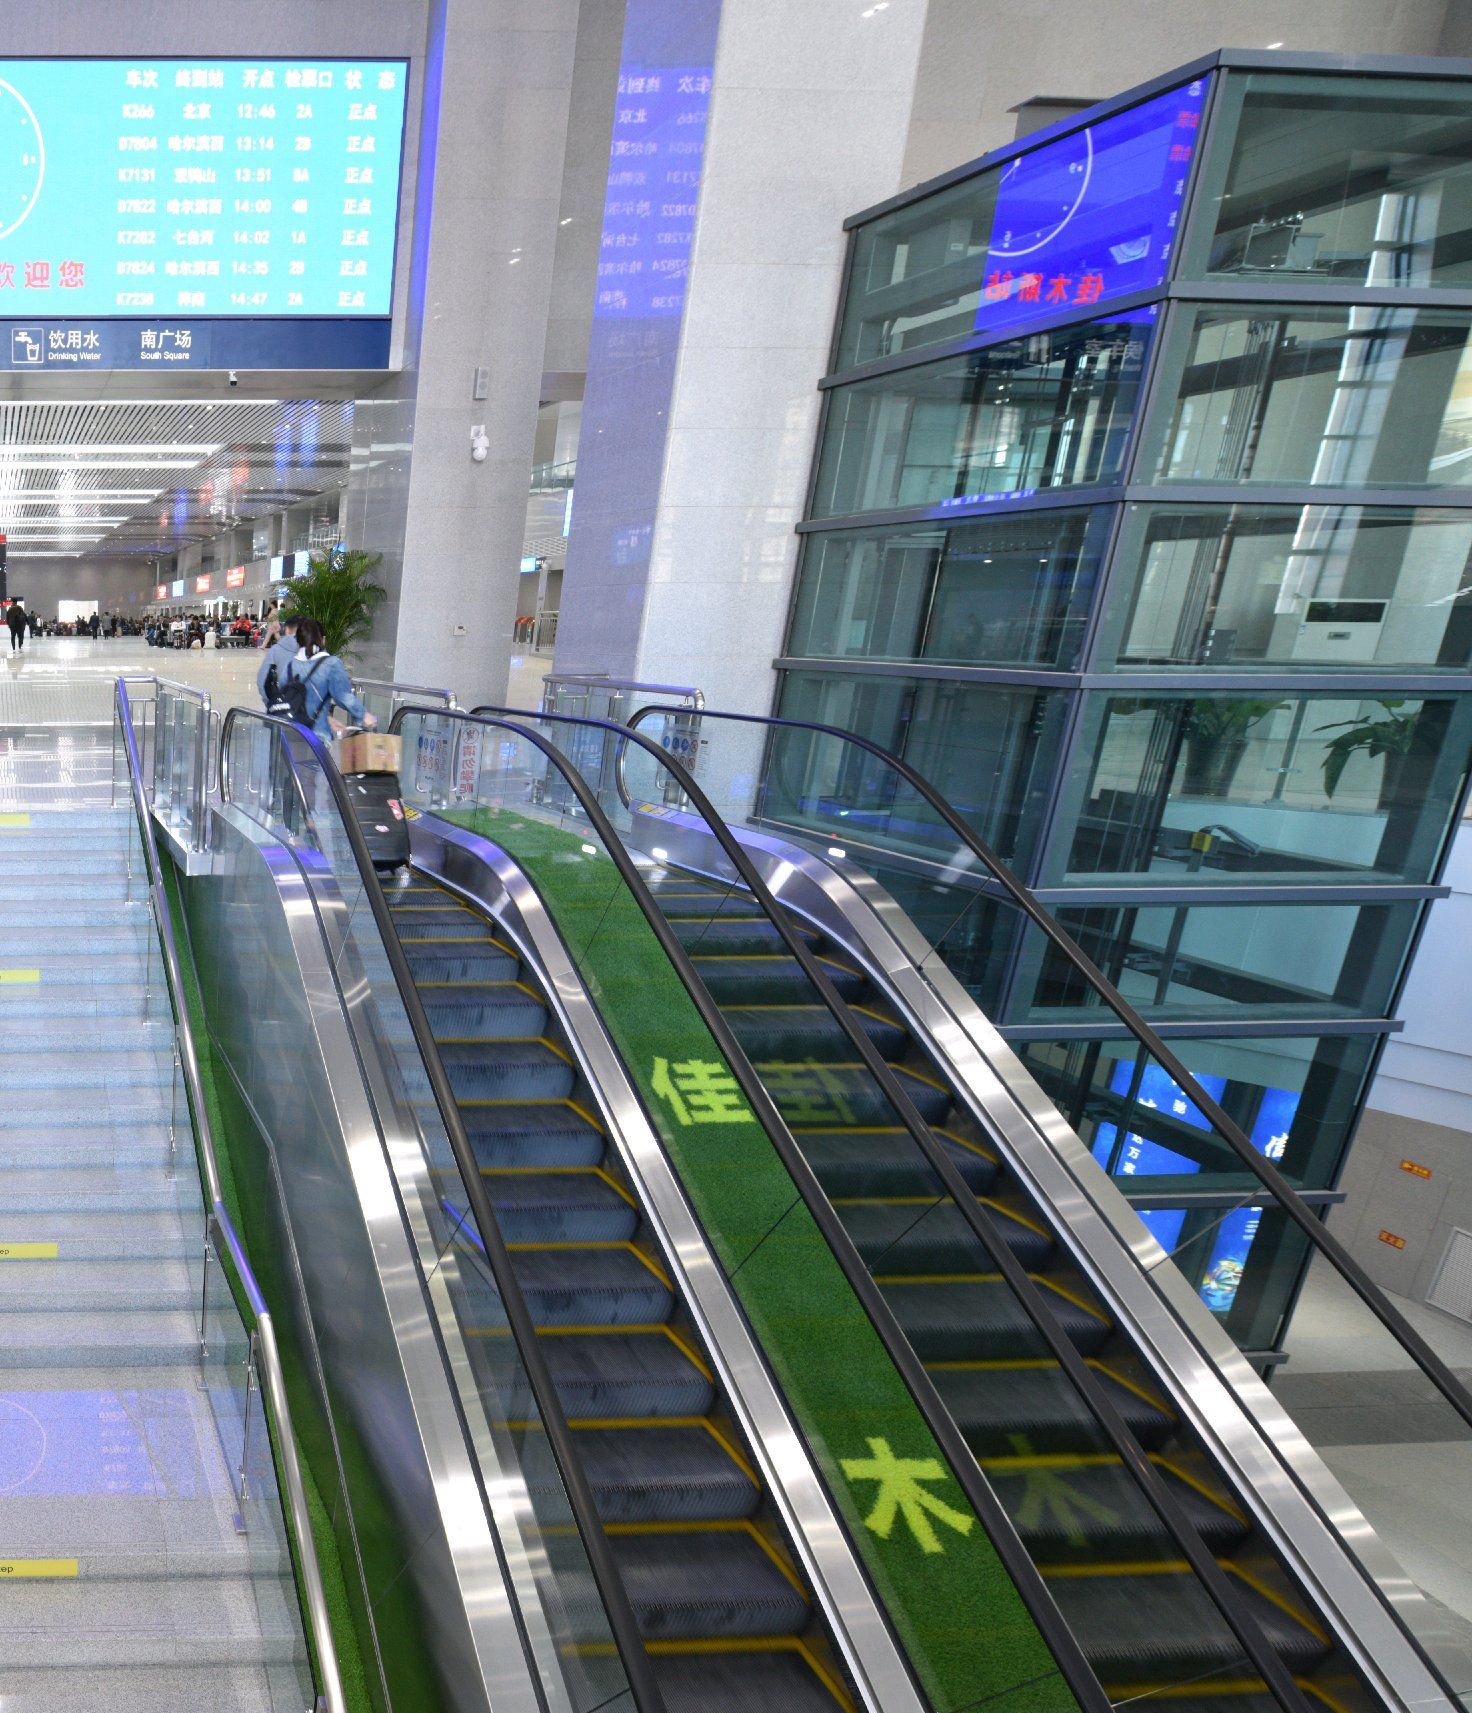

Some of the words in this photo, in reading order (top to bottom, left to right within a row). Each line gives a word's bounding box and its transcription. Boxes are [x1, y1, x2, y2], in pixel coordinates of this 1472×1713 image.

[126, 69, 158, 88] 车次
[243, 69, 274, 88] 开点
[183, 102, 211, 119] 北京
[238, 103, 276, 119] 12:46
[296, 104, 313, 119] 2A
[348, 103, 377, 120] 正点
[237, 136, 274, 151] 13:14
[347, 135, 375, 152] 正点
[345, 167, 373, 184] 正点
[235, 199, 272, 213] 14:00
[343, 198, 371, 214] 正点
[233, 230, 270, 244] 14:02
[292, 231, 306, 244] 1A
[341, 229, 369, 245] 正点
[340, 260, 367, 276] 正点
[231, 292, 267, 304] 14:47
[337, 291, 365, 306] 正点
[49, 330, 99, 348] 饮用水
[141, 329, 191, 348] 南广场
[48, 352, 77, 362] Drinking
[164, 352, 189, 360] Square
[652, 1056, 756, 1125] 佳
[839, 1436, 975, 1554] 木
